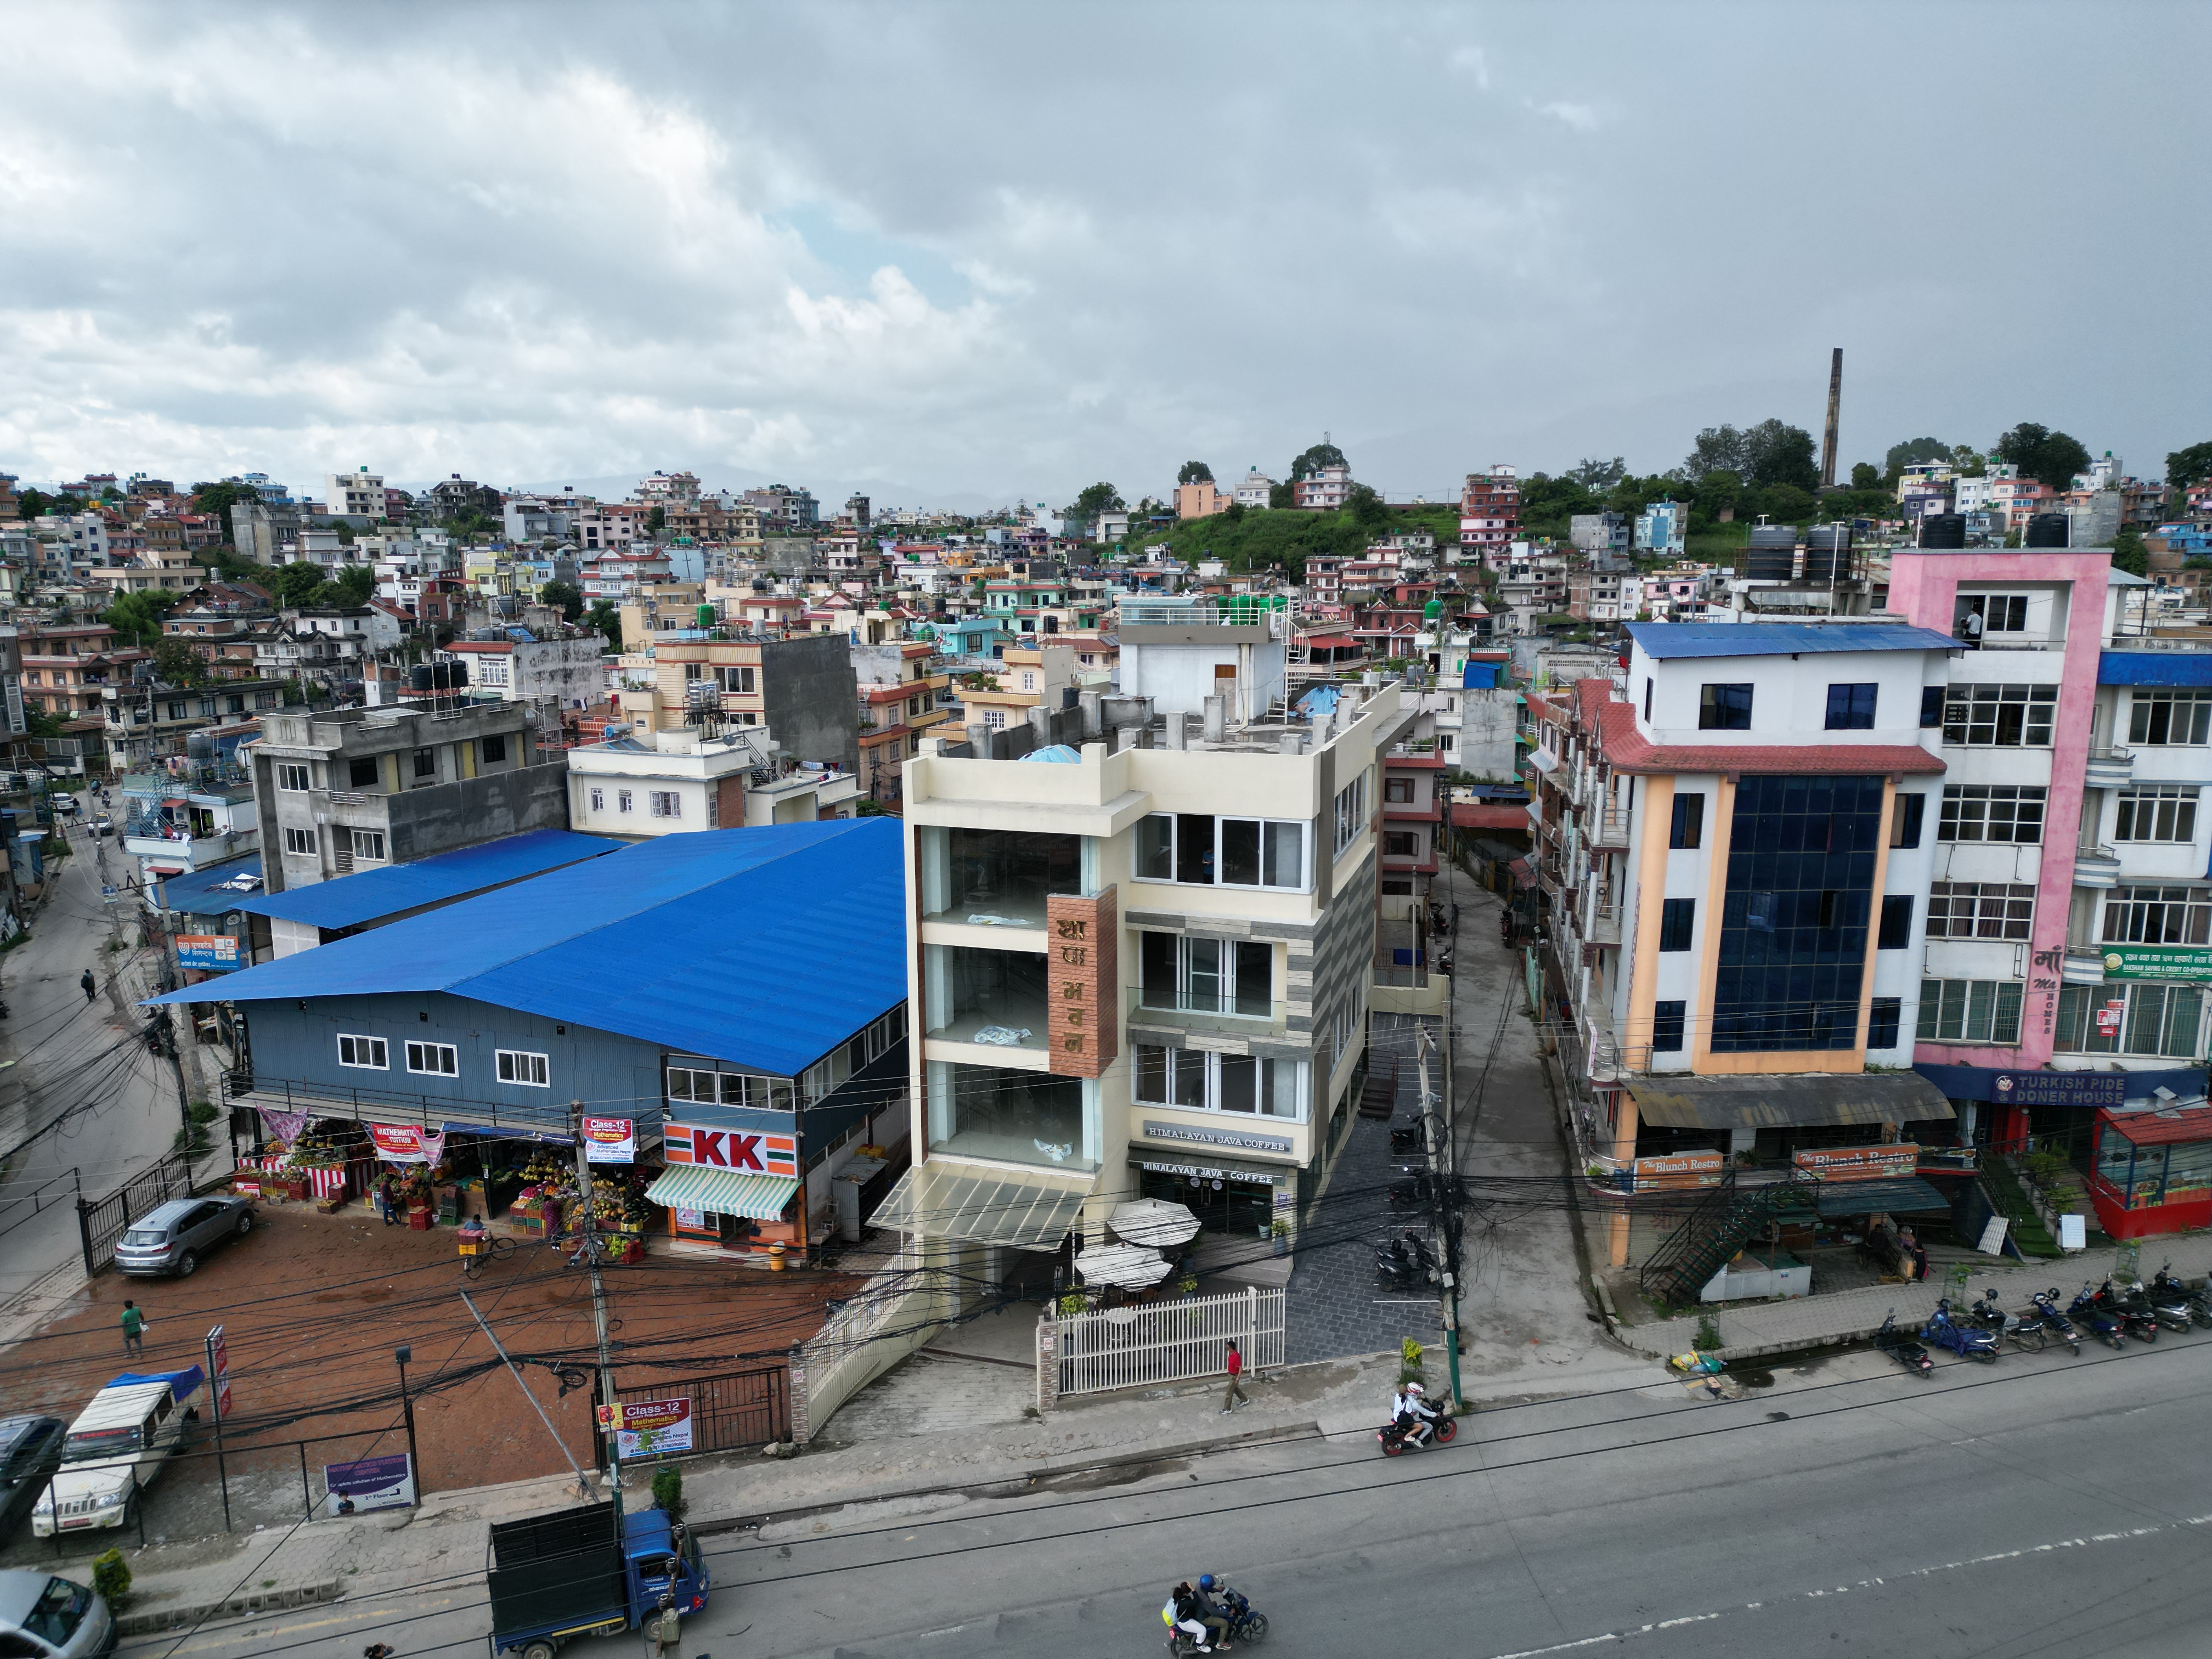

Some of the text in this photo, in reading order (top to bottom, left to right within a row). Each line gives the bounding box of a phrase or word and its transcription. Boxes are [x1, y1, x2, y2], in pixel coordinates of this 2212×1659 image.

[2044, 993, 2055, 1034] HOMES
[2018, 1076, 2125, 1091] TURKISH PIDE
[1999, 1090, 2124, 1105] & DONER HOUSE
[590, 1120, 625, 1130] Class-12
[377, 1128, 416, 1137] MATHEMATIC
[1148, 1127, 1285, 1152] HIMALAYAN JAVA COFFEE
[693, 1129, 765, 1171] KK
[1800, 1153, 1814, 1163] The
[1643, 1159, 1720, 1172] The Blunch Restro
[1143, 1162, 1273, 1184] HIMALAYAN JAVA COFFEE
[626, 1402, 680, 1416] Class-12
[631, 1415, 678, 1426] Mathematics
